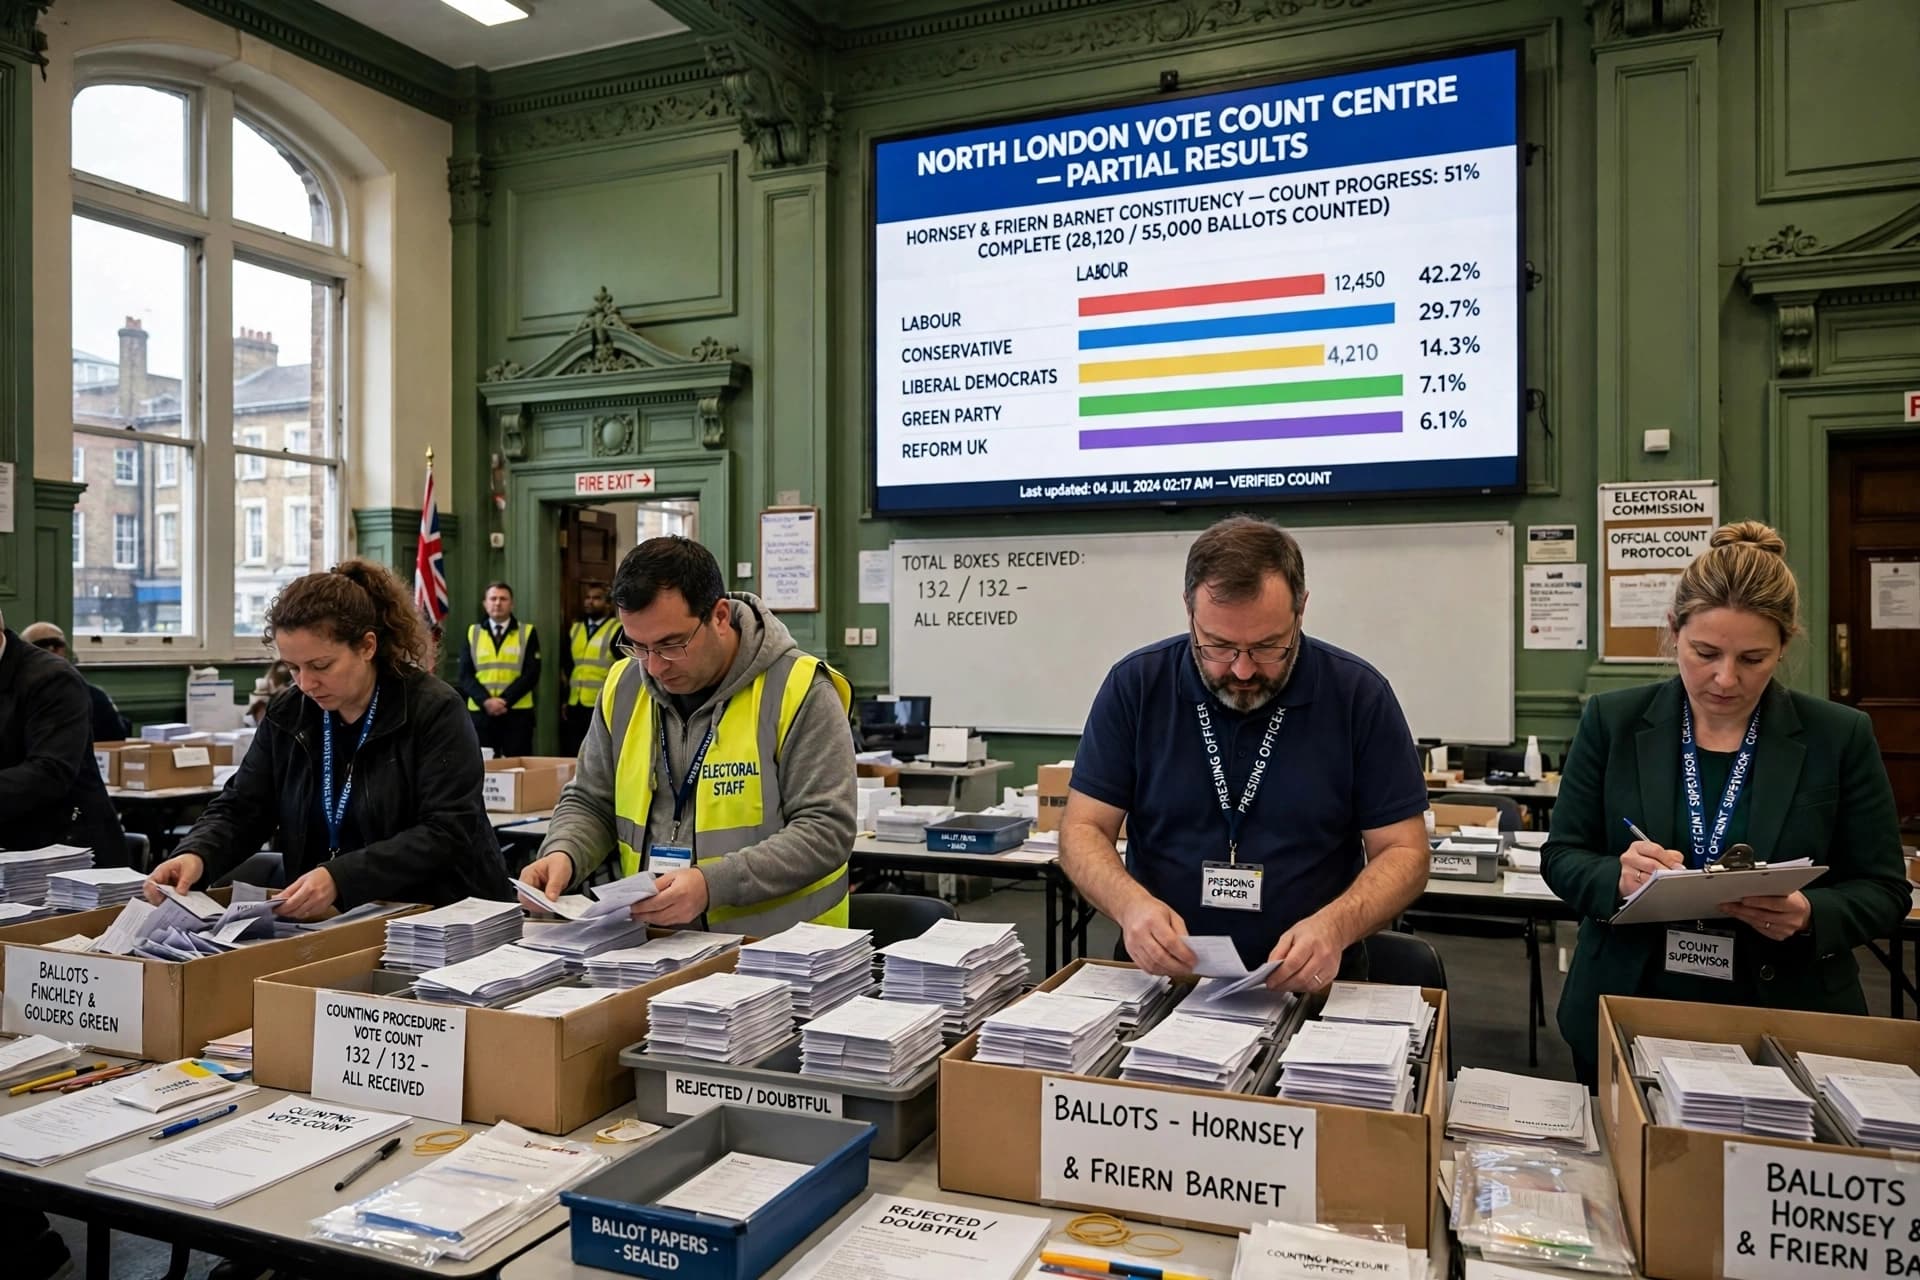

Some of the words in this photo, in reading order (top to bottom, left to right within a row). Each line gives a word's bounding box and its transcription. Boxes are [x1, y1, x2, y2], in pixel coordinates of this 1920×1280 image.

[918, 141, 1006, 176] NORTH
[1014, 124, 1129, 163] LONDON
[1136, 111, 1211, 145] VOTE
[1219, 95, 1324, 133] COUNT
[1332, 75, 1457, 117] CENTRE
[1067, 150, 1178, 187] PARTIAL
[1186, 132, 1308, 172] RESULTS
[907, 223, 976, 245] HORNSEY
[980, 222, 990, 236] &
[995, 215, 1047, 235] FRIERN
[1054, 207, 1114, 228] BARNET
[1120, 192, 1244, 220] CONSTITUENCY
[1269, 181, 1330, 202] COUNT
[1336, 169, 1438, 195] PROGRESS:
[1445, 163, 1479, 182] 51%
[978, 235, 1061, 258] COMPLETE
[1066, 228, 1124, 251] (28,120
[1129, 224, 1137, 244] /
[1142, 219, 1201, 241] 55,000
[1208, 209, 1287, 232] BALLOTS
[1292, 197, 1389, 225] COUNTED)
[1336, 271, 1384, 292] 12,450
[1419, 262, 1480, 283] 42.2%
[1420, 299, 1480, 320] 29.7%
[902, 312, 960, 331] LABOUR
[902, 339, 1012, 363] CONSERVATIVE
[1328, 344, 1378, 365] 4,210
[1421, 336, 1480, 356] 14.3%
[903, 376, 960, 394] LIBERAL
[966, 369, 1057, 390] DEMOCRATS
[1420, 373, 1466, 393] 7.1%
[902, 409, 949, 426] GREEN
[955, 405, 1001, 423] PARTY
[1421, 410, 1467, 430] 6.1%
[903, 441, 961, 458] REFORM
[968, 439, 987, 455] UK
[578, 476, 604, 491] FIRE
[608, 474, 634, 490] EXIT
[1020, 486, 1042, 498] Last
[1045, 482, 1091, 499] updated:
[1093, 482, 1107, 494] 04
[1110, 481, 1131, 493] JUL
[1133, 480, 1161, 492] 2024
[1163, 478, 1192, 491] 02:17
[1194, 477, 1213, 490] AM
[1230, 474, 1285, 488] VERIFIED
[1288, 471, 1332, 485] COUNT
[1615, 490, 1696, 503] ELECTORAL
[1613, 503, 1704, 515] COMMISSION
[1664, 531, 1707, 542] COUNT
[902, 555, 946, 571] TOTAL
[954, 553, 999, 569] BOXES
[1008, 551, 1084, 567] RECEIVED:
[1622, 547, 1693, 558] PROTOCOL
[919, 580, 950, 599] 132
[958, 576, 970, 603] /
[979, 579, 1009, 597] 132
[914, 612, 940, 626] ALL
[948, 611, 1017, 626] RECEIVED
[702, 762, 759, 779] ELECTORAL
[714, 780, 744, 795] STAFF
[1679, 940, 1719, 954] COUNT
[1668, 952, 1729, 968] SUPERVISOR
[40, 962, 88, 984] BALLOTS
[32, 983, 83, 1006] FINCHLEY
[88, 993, 95, 1008] &
[25, 1004, 73, 1025] GOLDERS
[80, 1012, 118, 1032] GREEN
[327, 1004, 379, 1022] COUNTING
[383, 1011, 446, 1032] PROCEDURE
[354, 1026, 381, 1041] VOTE
[385, 1031, 423, 1047] COUNT
[346, 1045, 370, 1064] 132
[377, 1047, 386, 1069] /
[392, 1052, 415, 1071] 132
[343, 1070, 363, 1086] ALL
[368, 1074, 424, 1096] RECEIVED
[676, 1079, 742, 1100] REJECTED
[747, 1087, 753, 1104] /
[758, 1090, 831, 1113] DOUBTFUL
[304, 1121, 352, 1132] COUNT
[1055, 1095, 1157, 1130] BALLOTS
[1193, 1111, 1304, 1149] HORNSEY
[1064, 1156, 1079, 1179] &
[1092, 1159, 1172, 1192] FRIERN
[1187, 1171, 1286, 1207] BARNET
[1767, 1163, 1906, 1206] BALLOTS
[880, 1215, 980, 1240] DOUBTFUL
[888, 1205, 981, 1227] REJECTED
[984, 1221, 997, 1230] /
[1772, 1199, 1895, 1240] HORNSEY
[592, 1217, 646, 1241] BALLOT
[651, 1229, 708, 1254] PAPERS
[624, 1244, 679, 1270] SEALED
[1737, 1231, 1755, 1256] &
[1771, 1234, 1867, 1271] FRIERN
